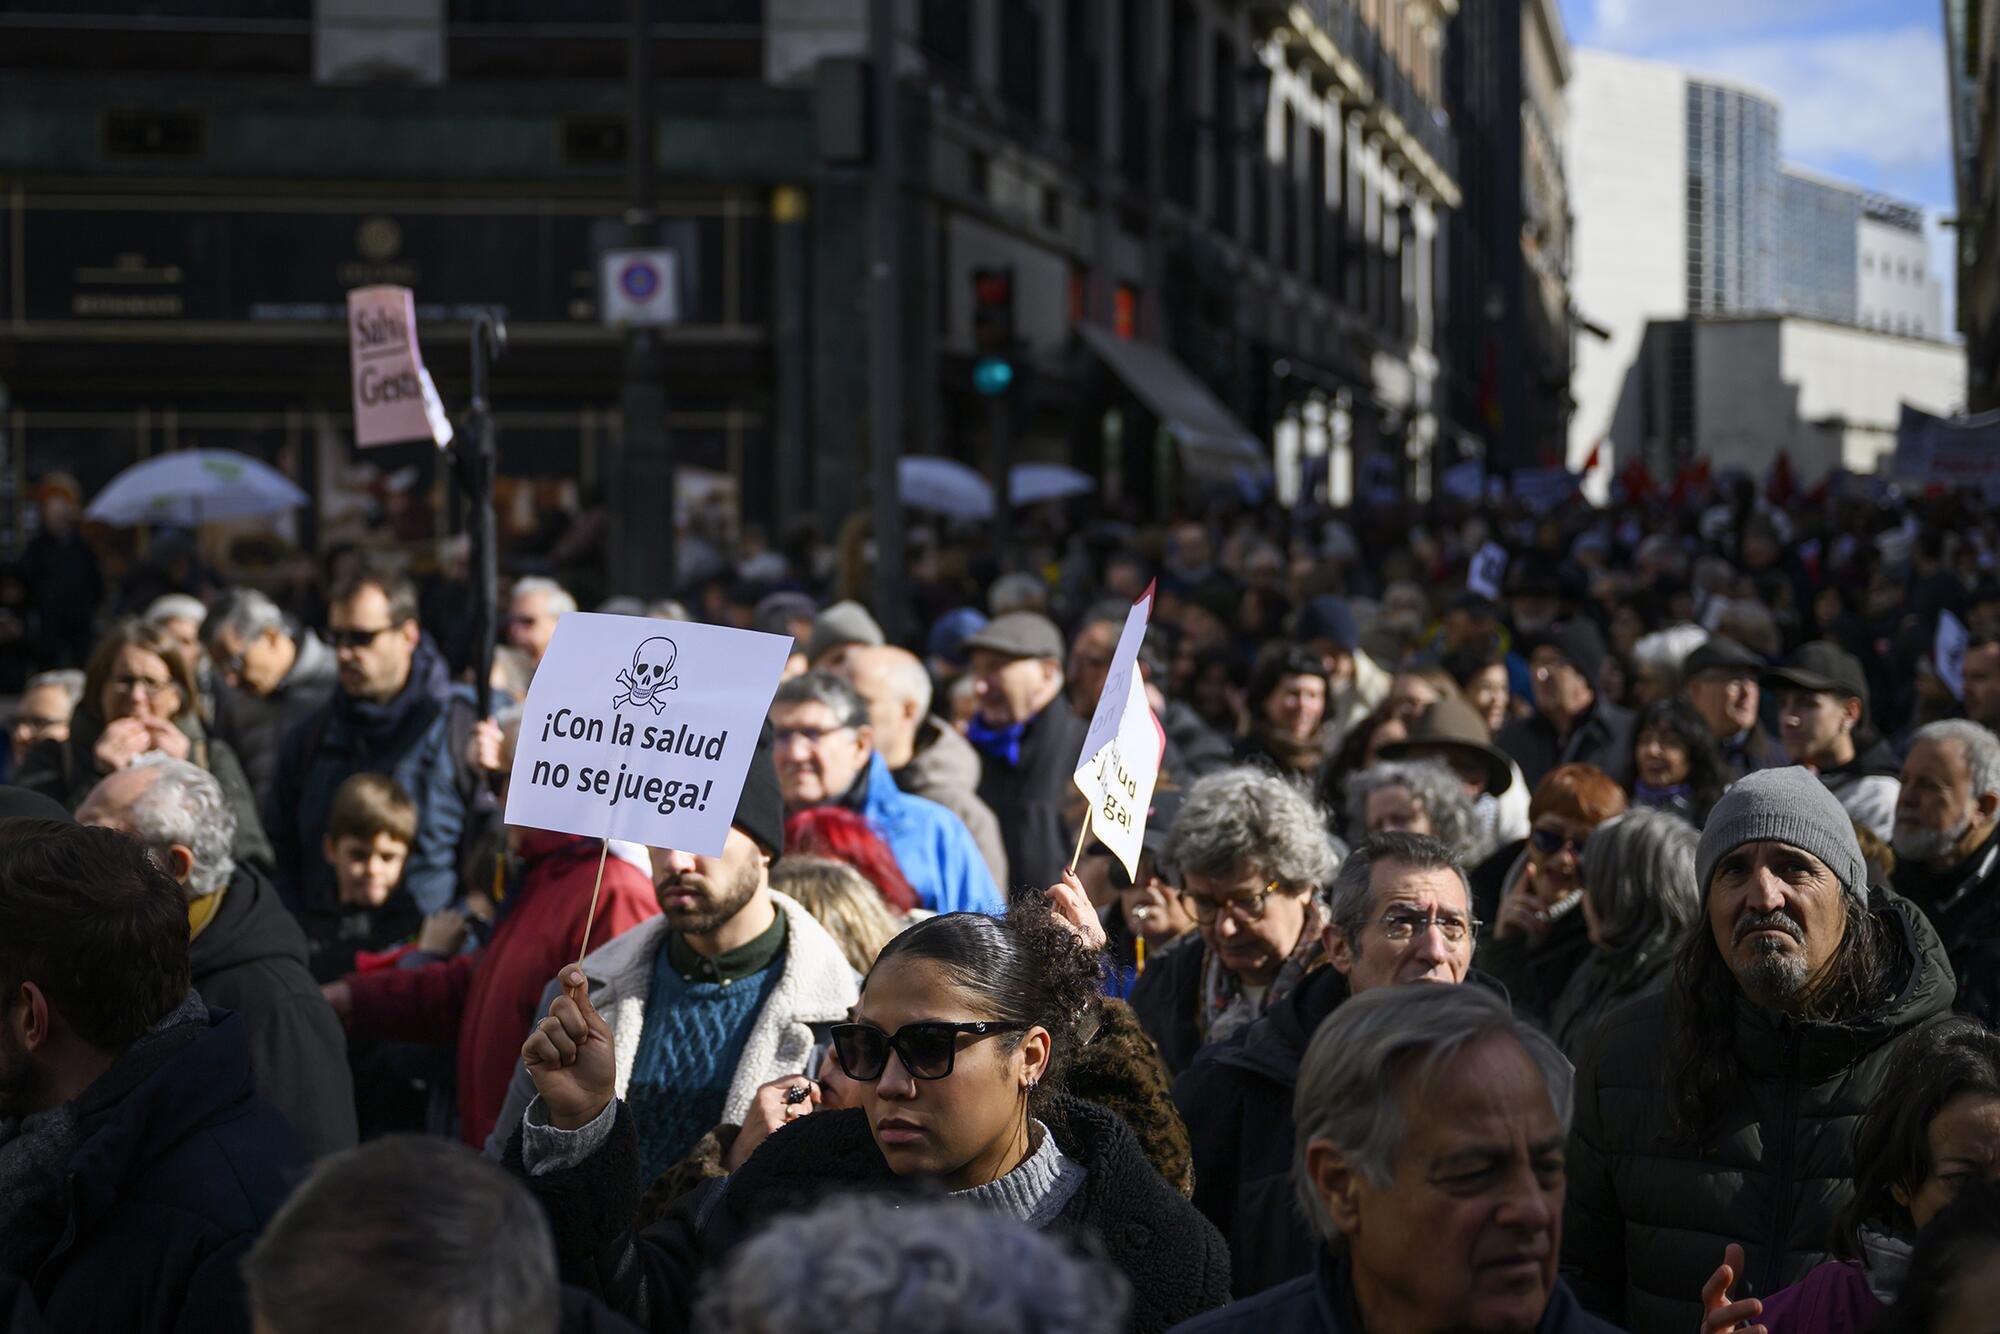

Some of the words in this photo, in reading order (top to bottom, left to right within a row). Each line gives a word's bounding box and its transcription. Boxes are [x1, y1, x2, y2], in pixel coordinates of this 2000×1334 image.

[541, 708, 603, 743] ¡Con
[611, 713, 635, 746] la
[640, 723, 728, 762] salud
[531, 760, 569, 789] no
[576, 766, 610, 795] se
[609, 763, 713, 815] juega!
